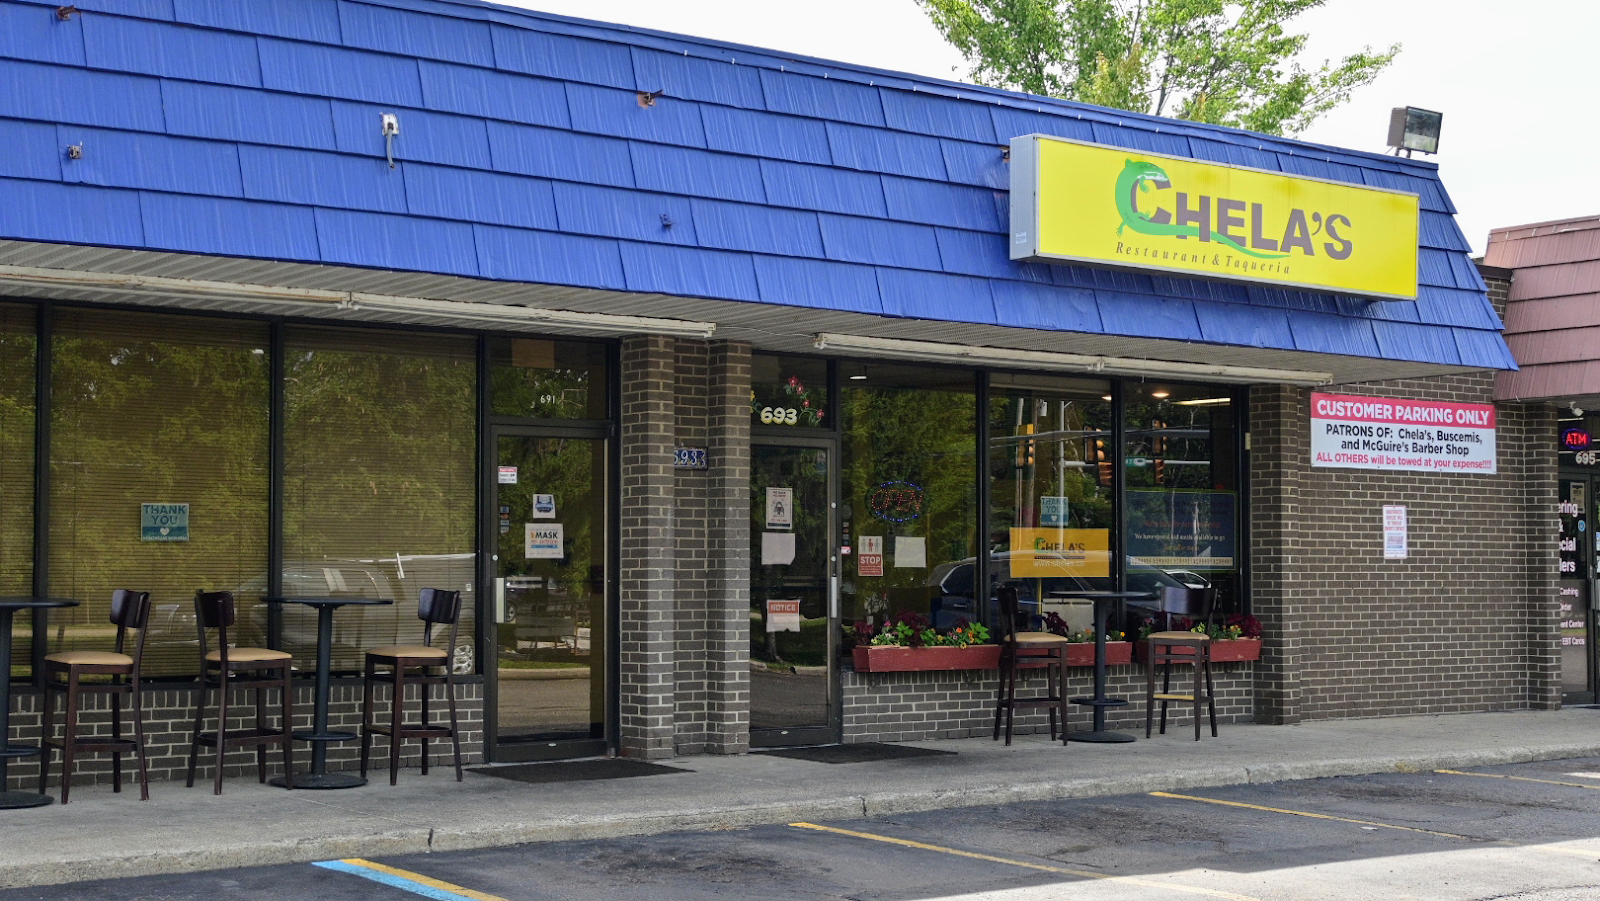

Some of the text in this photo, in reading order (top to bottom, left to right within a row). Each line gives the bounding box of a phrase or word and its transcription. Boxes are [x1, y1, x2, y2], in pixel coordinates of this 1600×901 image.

[1128, 174, 1353, 261] CHELA'S
[1116, 242, 1290, 274] Restaurant & Taqueria
[540, 394, 555, 404] 691
[760, 406, 798, 425] 693
[1317, 399, 1490, 426] CUSTOMER PARKING ONLY
[1326, 424, 1483, 445] PATRONS OF: Chela's, Buscemis,
[1565, 432, 1588, 445] ATM
[1341, 439, 1470, 457] and McGuire's Barber Shop
[1316, 452, 1333, 462] ALL
[1334, 453, 1369, 464] OTHERS
[1371, 454, 1385, 465] will
[1386, 455, 1396, 466] be
[1398, 456, 1422, 466] towed
[1424, 458, 1432, 467] at
[1434, 459, 1451, 469] your
[1575, 451, 1596, 465] 695
[871, 488, 923, 512] OPEN
[143, 504, 187, 515] THANK
[152, 515, 178, 525] YOU
[535, 531, 558, 539] MASK
[860, 555, 881, 564] STOP
[770, 603, 796, 611] NOTICE
